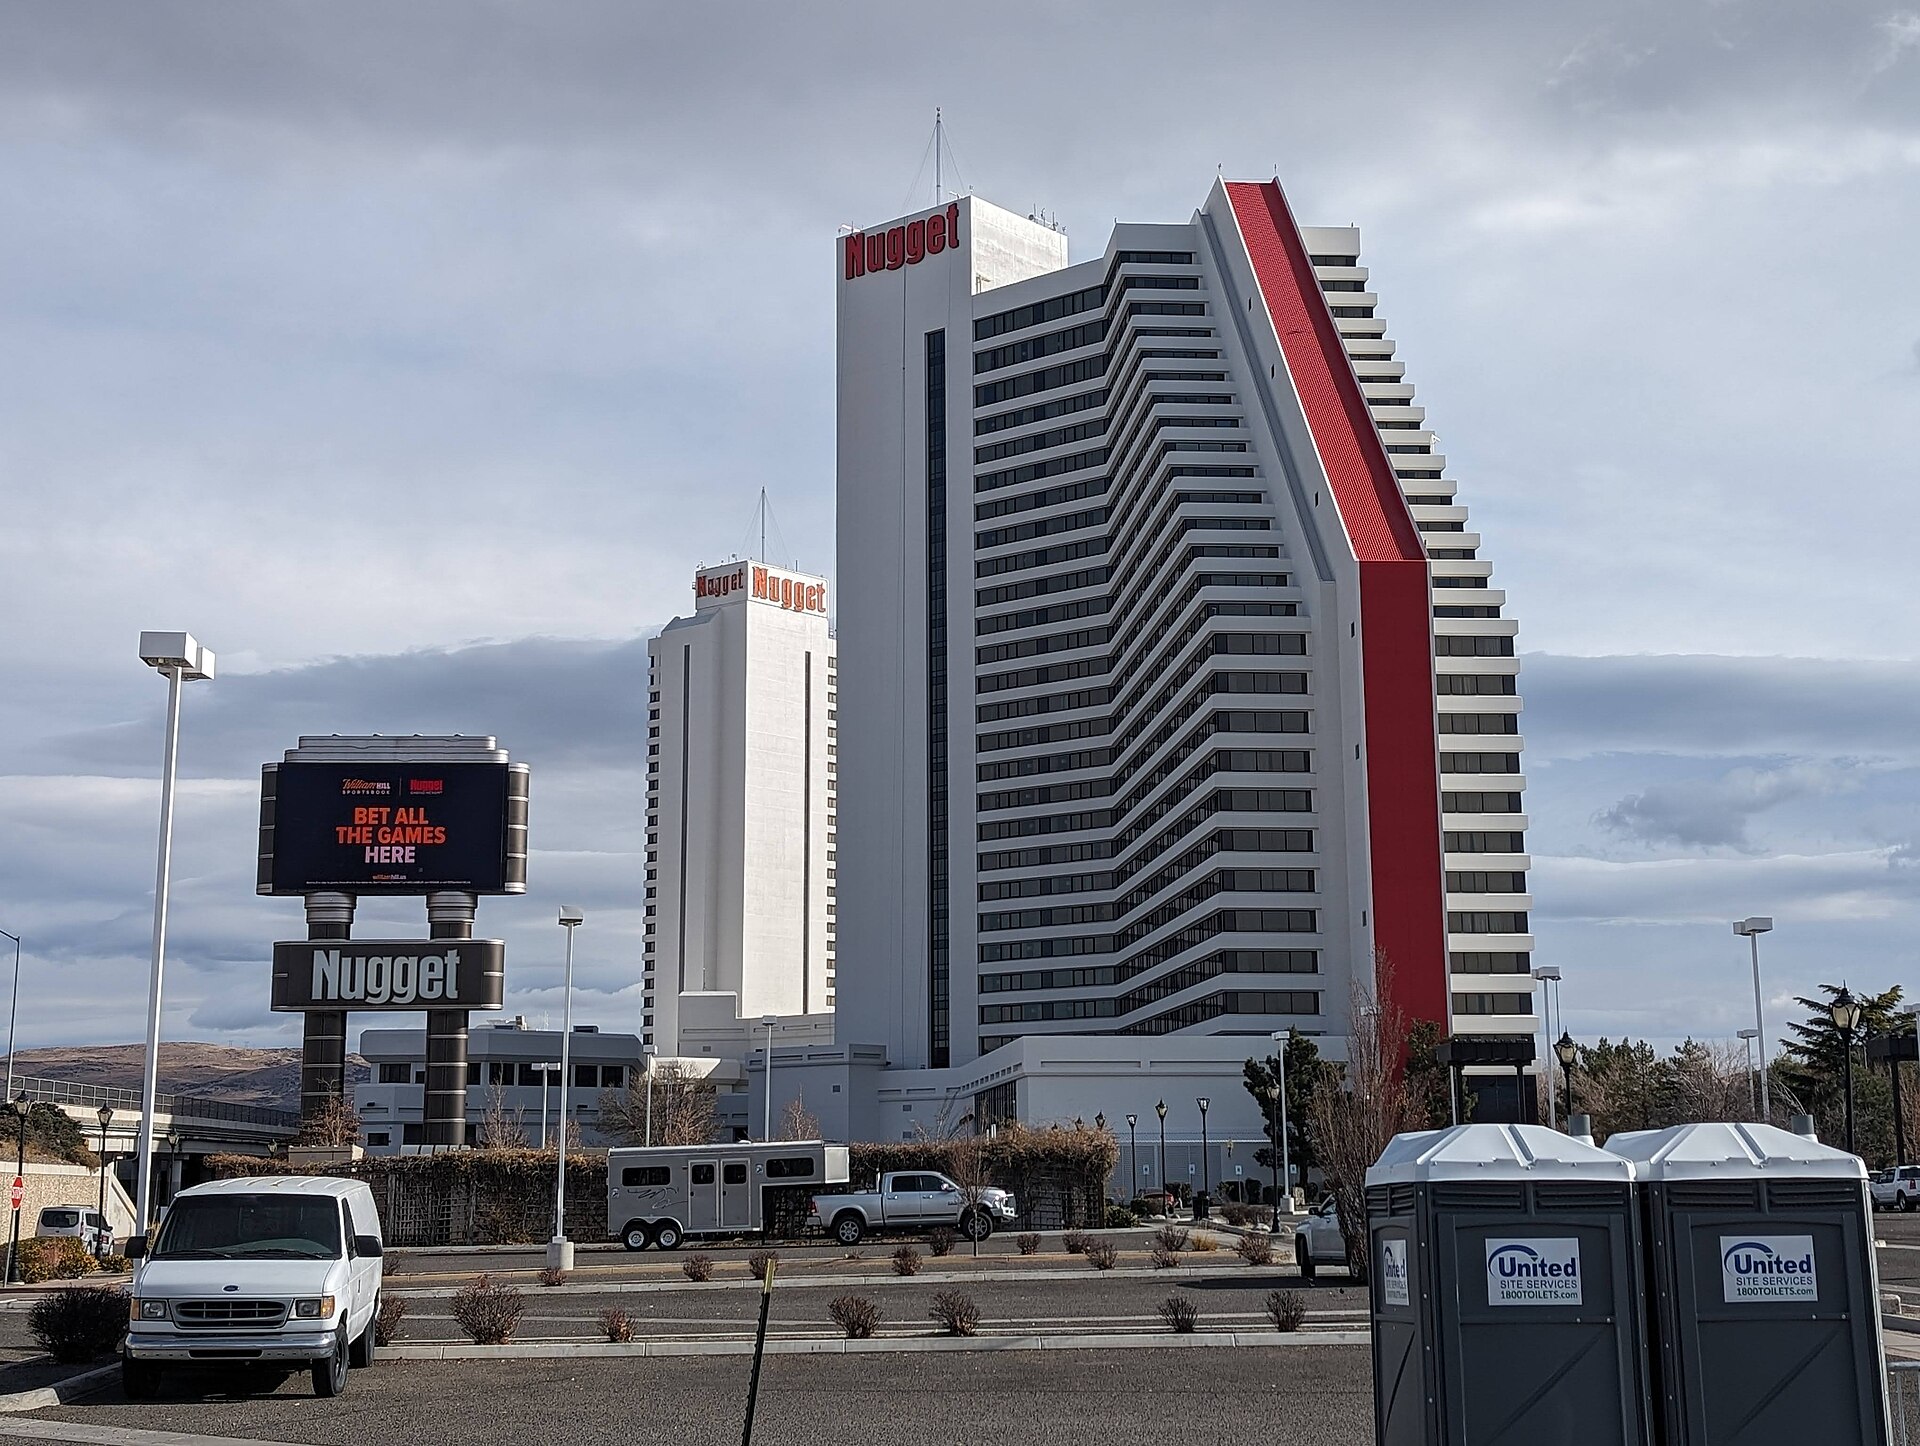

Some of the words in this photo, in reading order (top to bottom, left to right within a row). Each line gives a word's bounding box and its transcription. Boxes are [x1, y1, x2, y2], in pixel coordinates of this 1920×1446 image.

[845, 202, 960, 280] Nugget
[696, 568, 744, 598] Nugget
[752, 566, 826, 612] Nugget
[342, 779, 377, 790] William
[376, 782, 391, 790] HILL
[354, 807, 391, 825] BET
[394, 807, 429, 825] ALL
[335, 826, 373, 844] THE
[377, 826, 446, 844] GAMES
[364, 846, 416, 863] HERE
[311, 948, 461, 1004] Nugget
[1498, 1256, 1577, 1278] United
[1734, 1253, 1812, 1275] United
[1500, 1280, 1523, 1289] SITE
[1526, 1280, 1578, 1289] SERVICES
[1736, 1277, 1759, 1286] SITE
[1762, 1276, 1813, 1286] SERVICES
[1501, 1290, 1578, 1299] 1800TOILETS.com
[1737, 1287, 1814, 1296] 1800TOILETS.com
